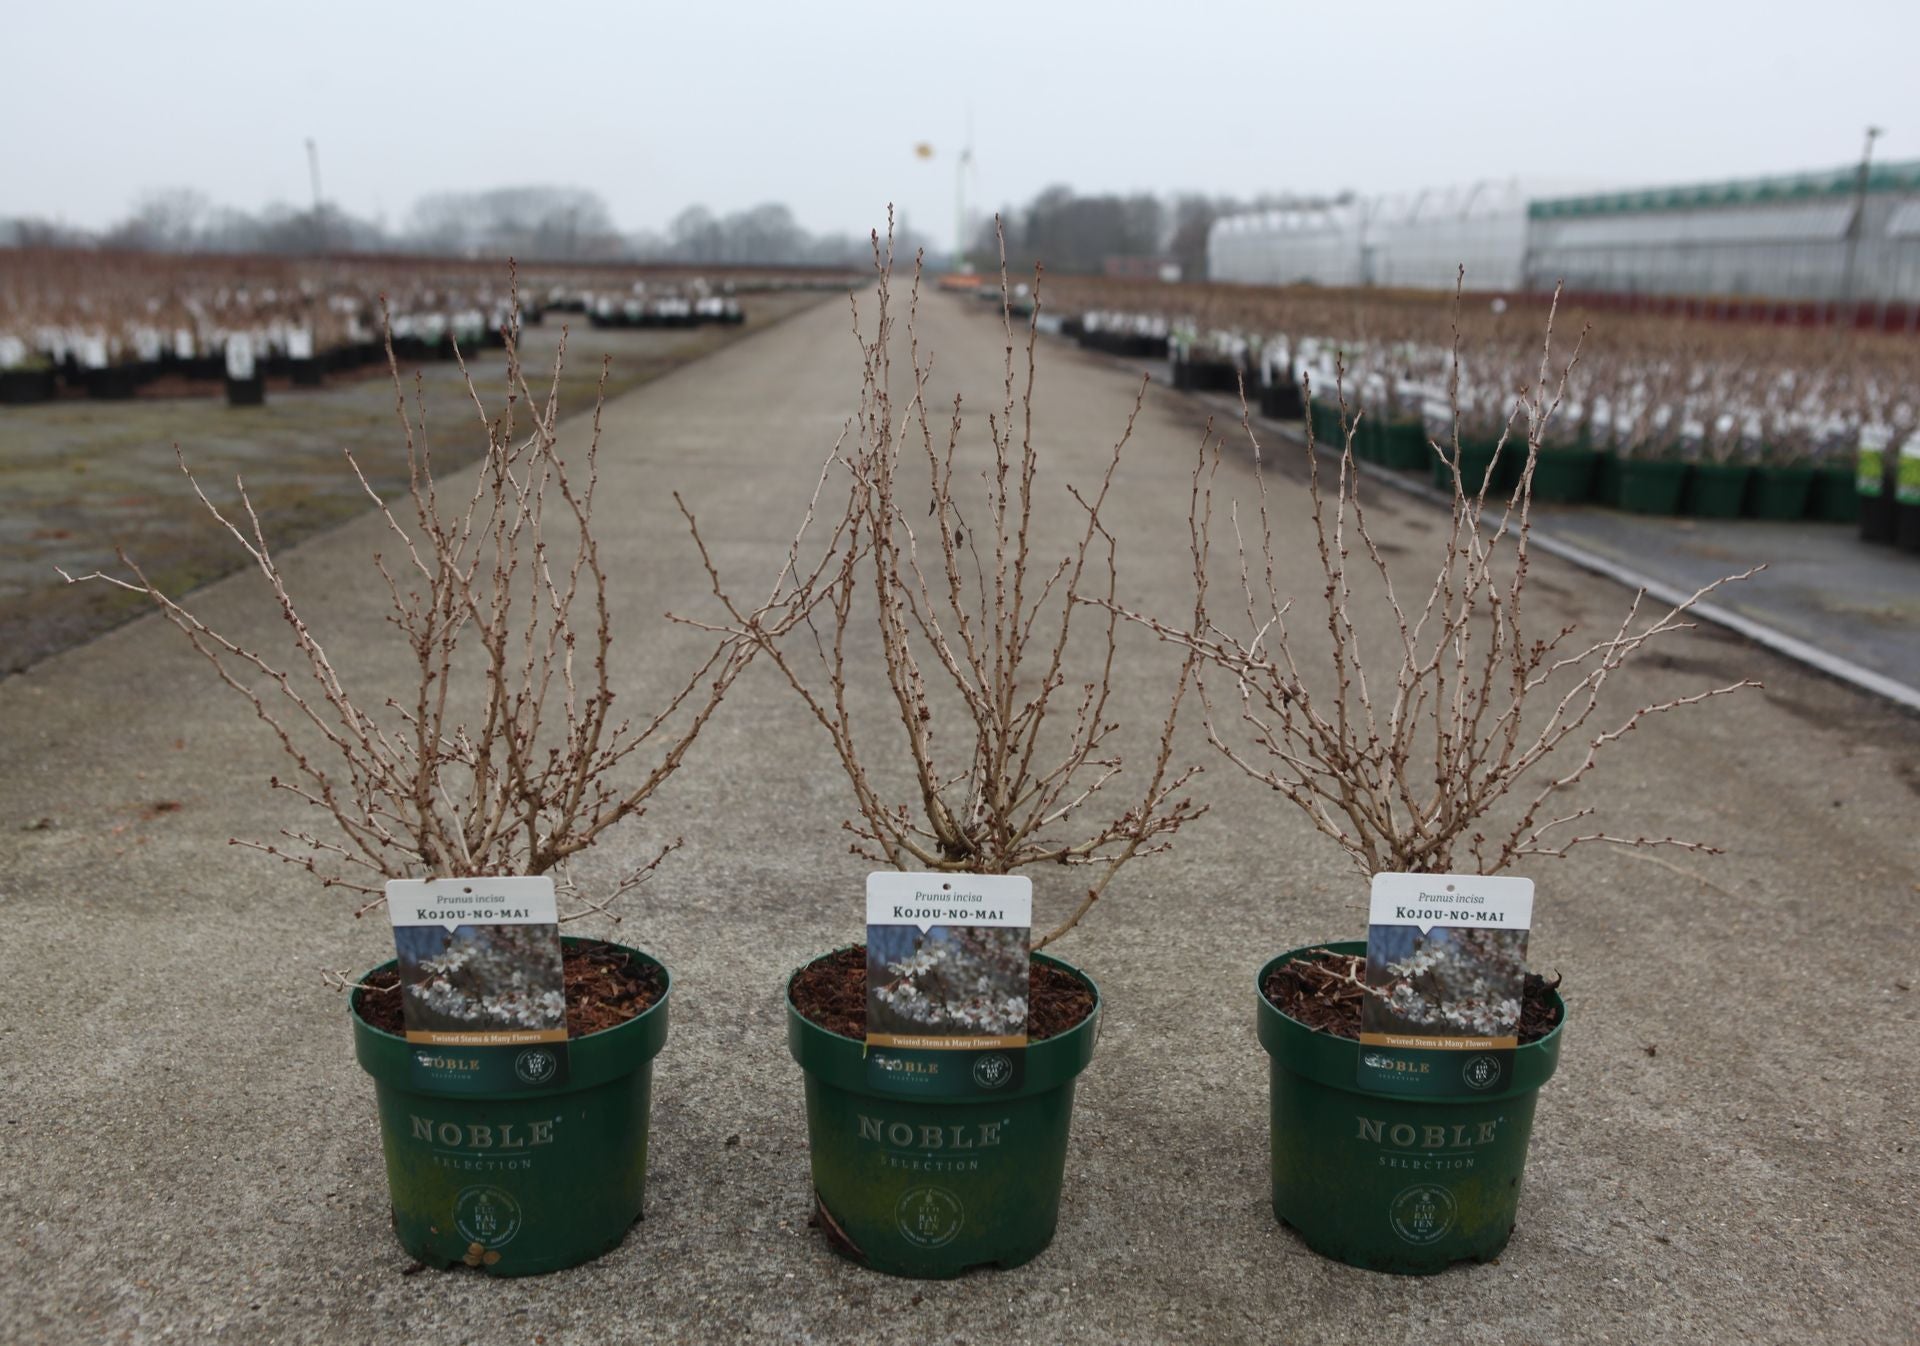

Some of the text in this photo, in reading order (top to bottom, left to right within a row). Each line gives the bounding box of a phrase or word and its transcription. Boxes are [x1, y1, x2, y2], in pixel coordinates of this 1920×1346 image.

[437, 894, 505, 904] Prunus incisa
[914, 891, 983, 903] Prunus incisa
[1418, 892, 1485, 904] Prunus incisa
[416, 908, 530, 920] KOJOU-NO-MAI
[893, 906, 1004, 920] KOJOU-NO-MAI
[1396, 906, 1505, 922] KOJOU-NO-MAI
[432, 1034, 541, 1044] Twisted Stems & Many Flowers
[892, 1038, 1001, 1048] Twisted Stems & Many Flowers
[1386, 1037, 1493, 1048] Twisted Stems & Many Flowers
[422, 1055, 480, 1071] OBLE
[880, 1058, 939, 1074] OBLE
[1373, 1058, 1430, 1073] OBLE
[433, 1156, 532, 1170] SELECTION
[880, 1157, 979, 1171] SELECTION
[1378, 1155, 1475, 1170] SELECTION
